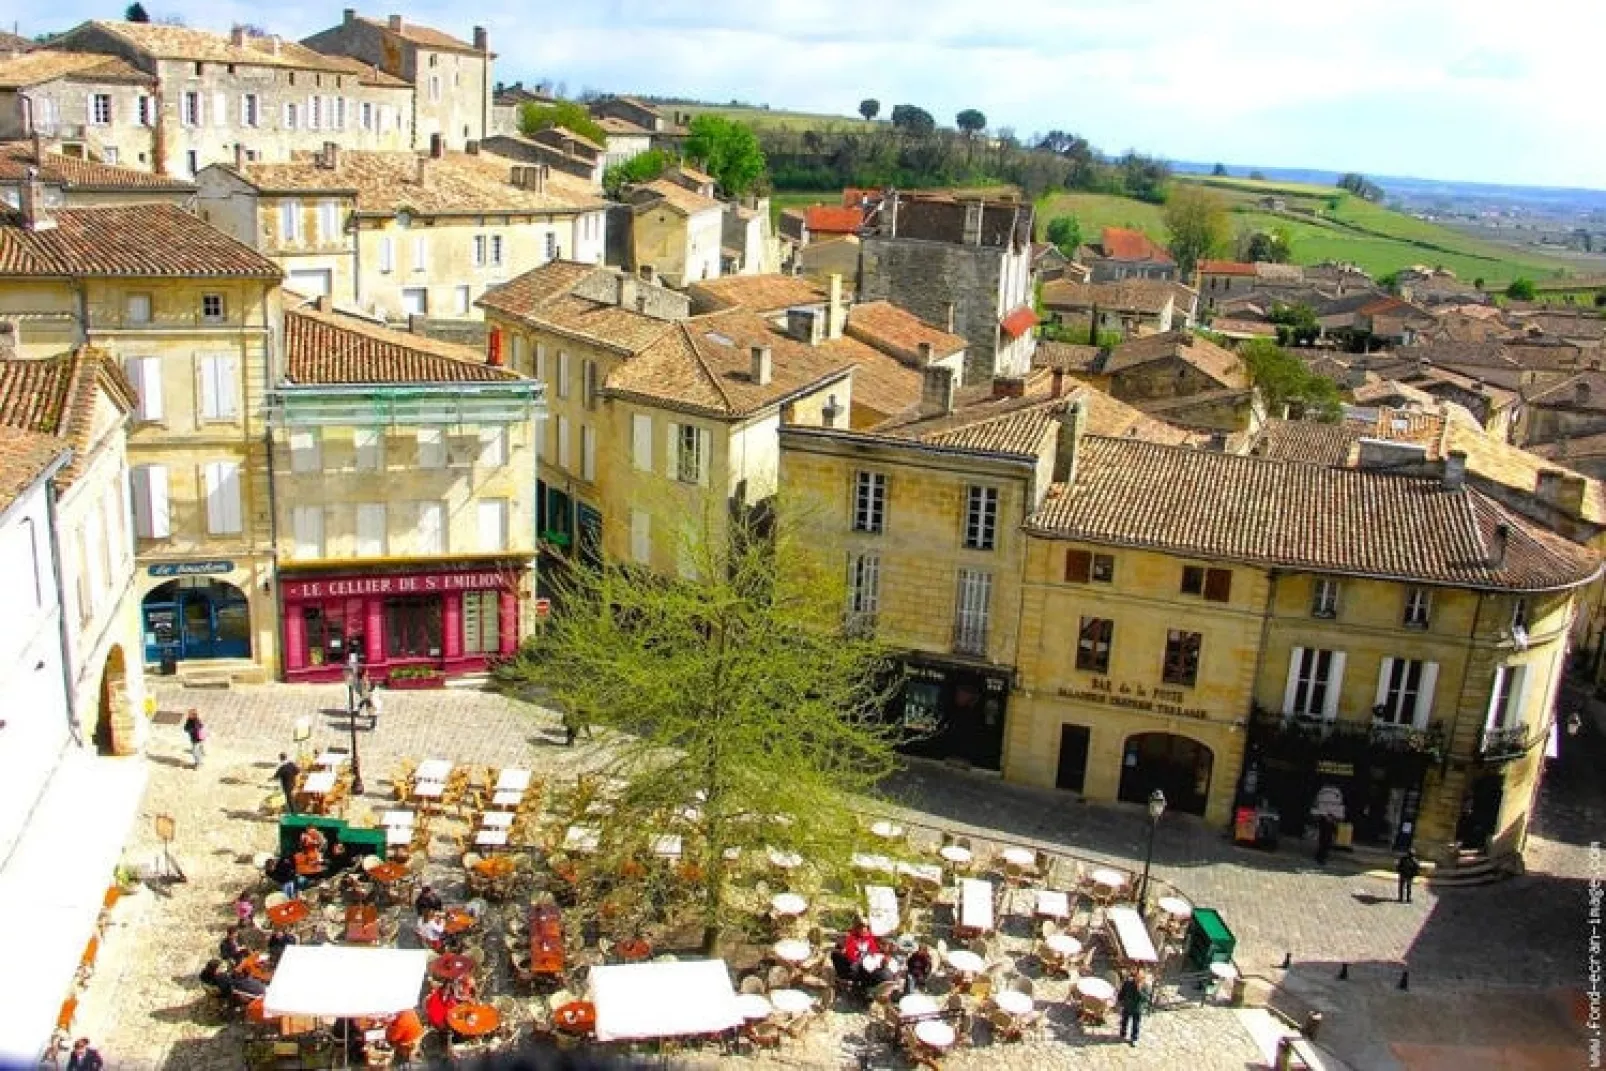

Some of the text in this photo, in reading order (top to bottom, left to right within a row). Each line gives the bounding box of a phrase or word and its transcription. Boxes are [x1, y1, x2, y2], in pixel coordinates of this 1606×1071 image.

[303, 582, 321, 597] LE
[329, 578, 391, 596] CELLIER
[399, 577, 417, 591] DE
[444, 572, 504, 589] EMILION
[1092, 678, 1112, 692] BAR
